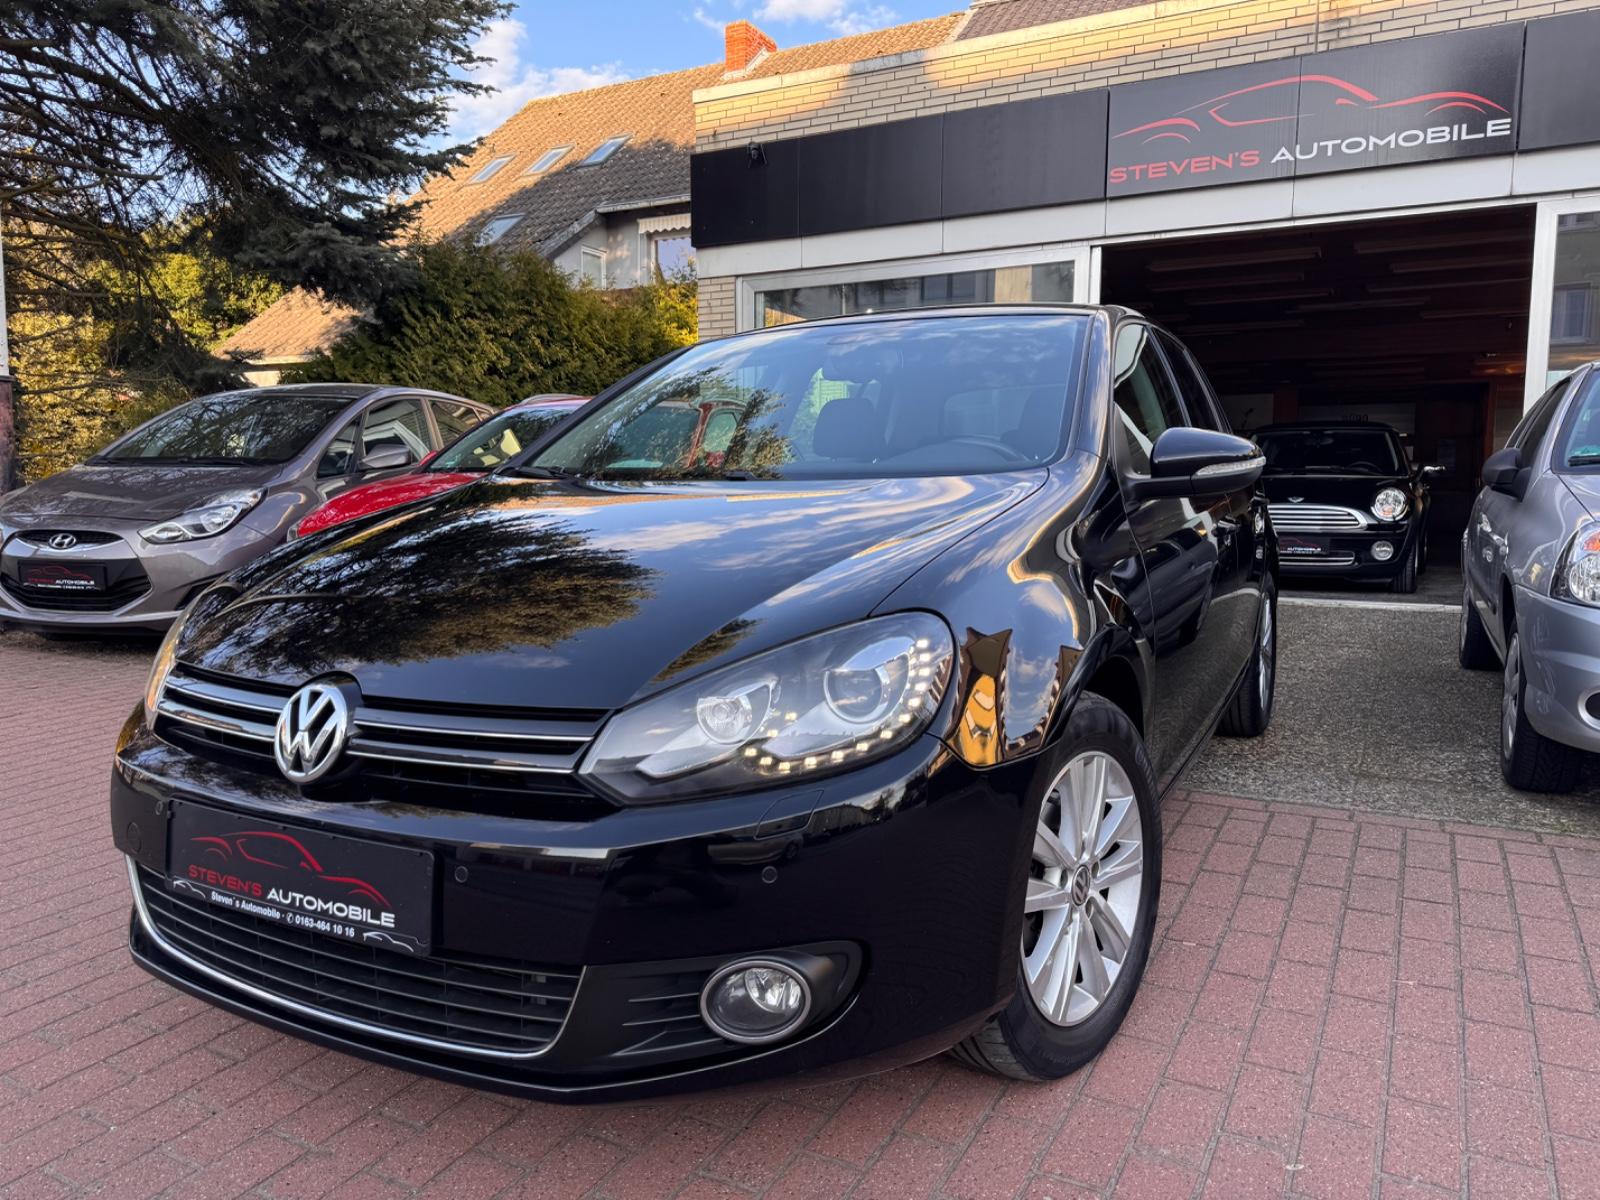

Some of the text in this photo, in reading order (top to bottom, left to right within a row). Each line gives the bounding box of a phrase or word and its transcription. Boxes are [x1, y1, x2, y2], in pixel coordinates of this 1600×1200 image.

[1109, 118, 1511, 184] STEVEN'S AUTOMOBILE
[188, 864, 396, 928] STEVEN'S AUTOMOBILE
[241, 900, 281, 919] Automobile
[295, 915, 331, 932] 0163-464
[332, 924, 343, 935] 10
[345, 927, 355, 937] 16
